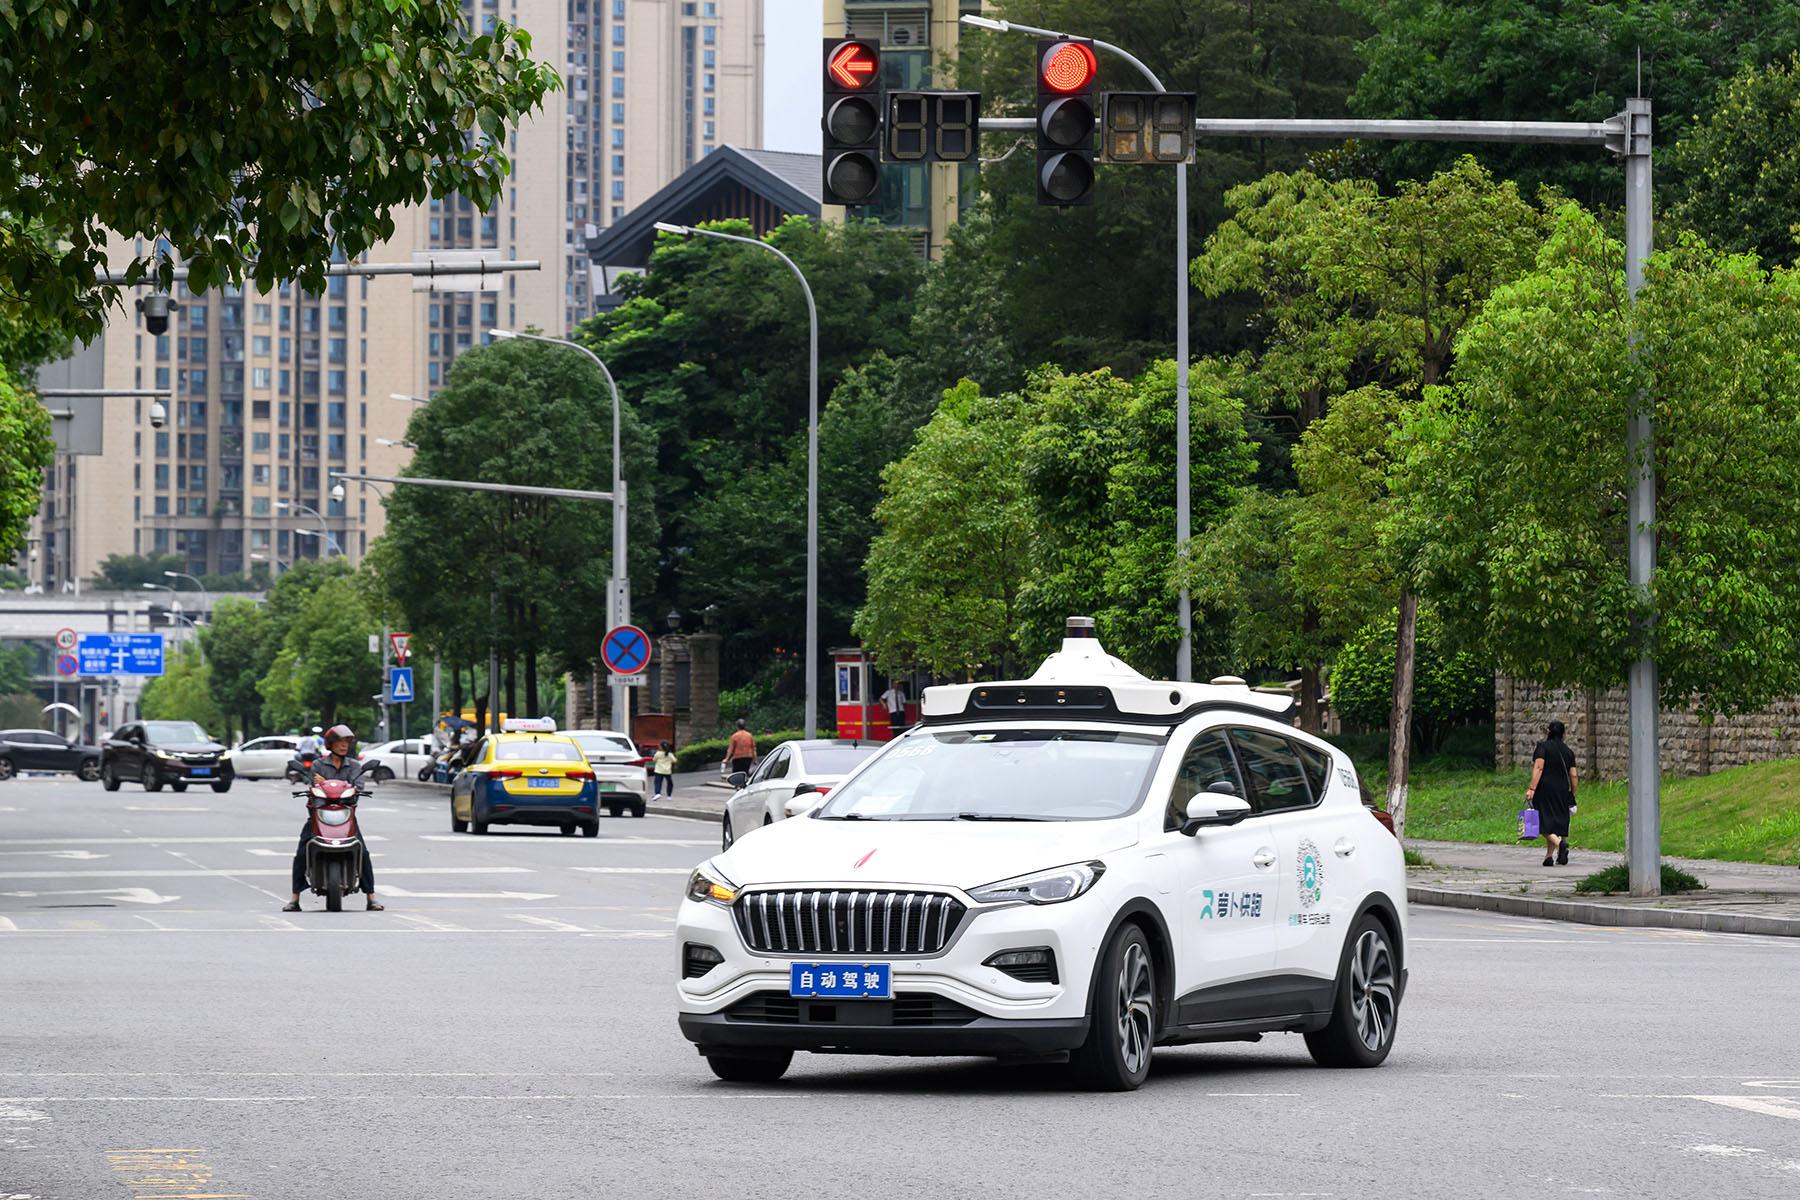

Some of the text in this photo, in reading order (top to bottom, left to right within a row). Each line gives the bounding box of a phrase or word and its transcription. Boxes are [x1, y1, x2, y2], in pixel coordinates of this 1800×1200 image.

[60, 633, 73, 644] 40
[800, 971, 880, 989] 自动驾驶
